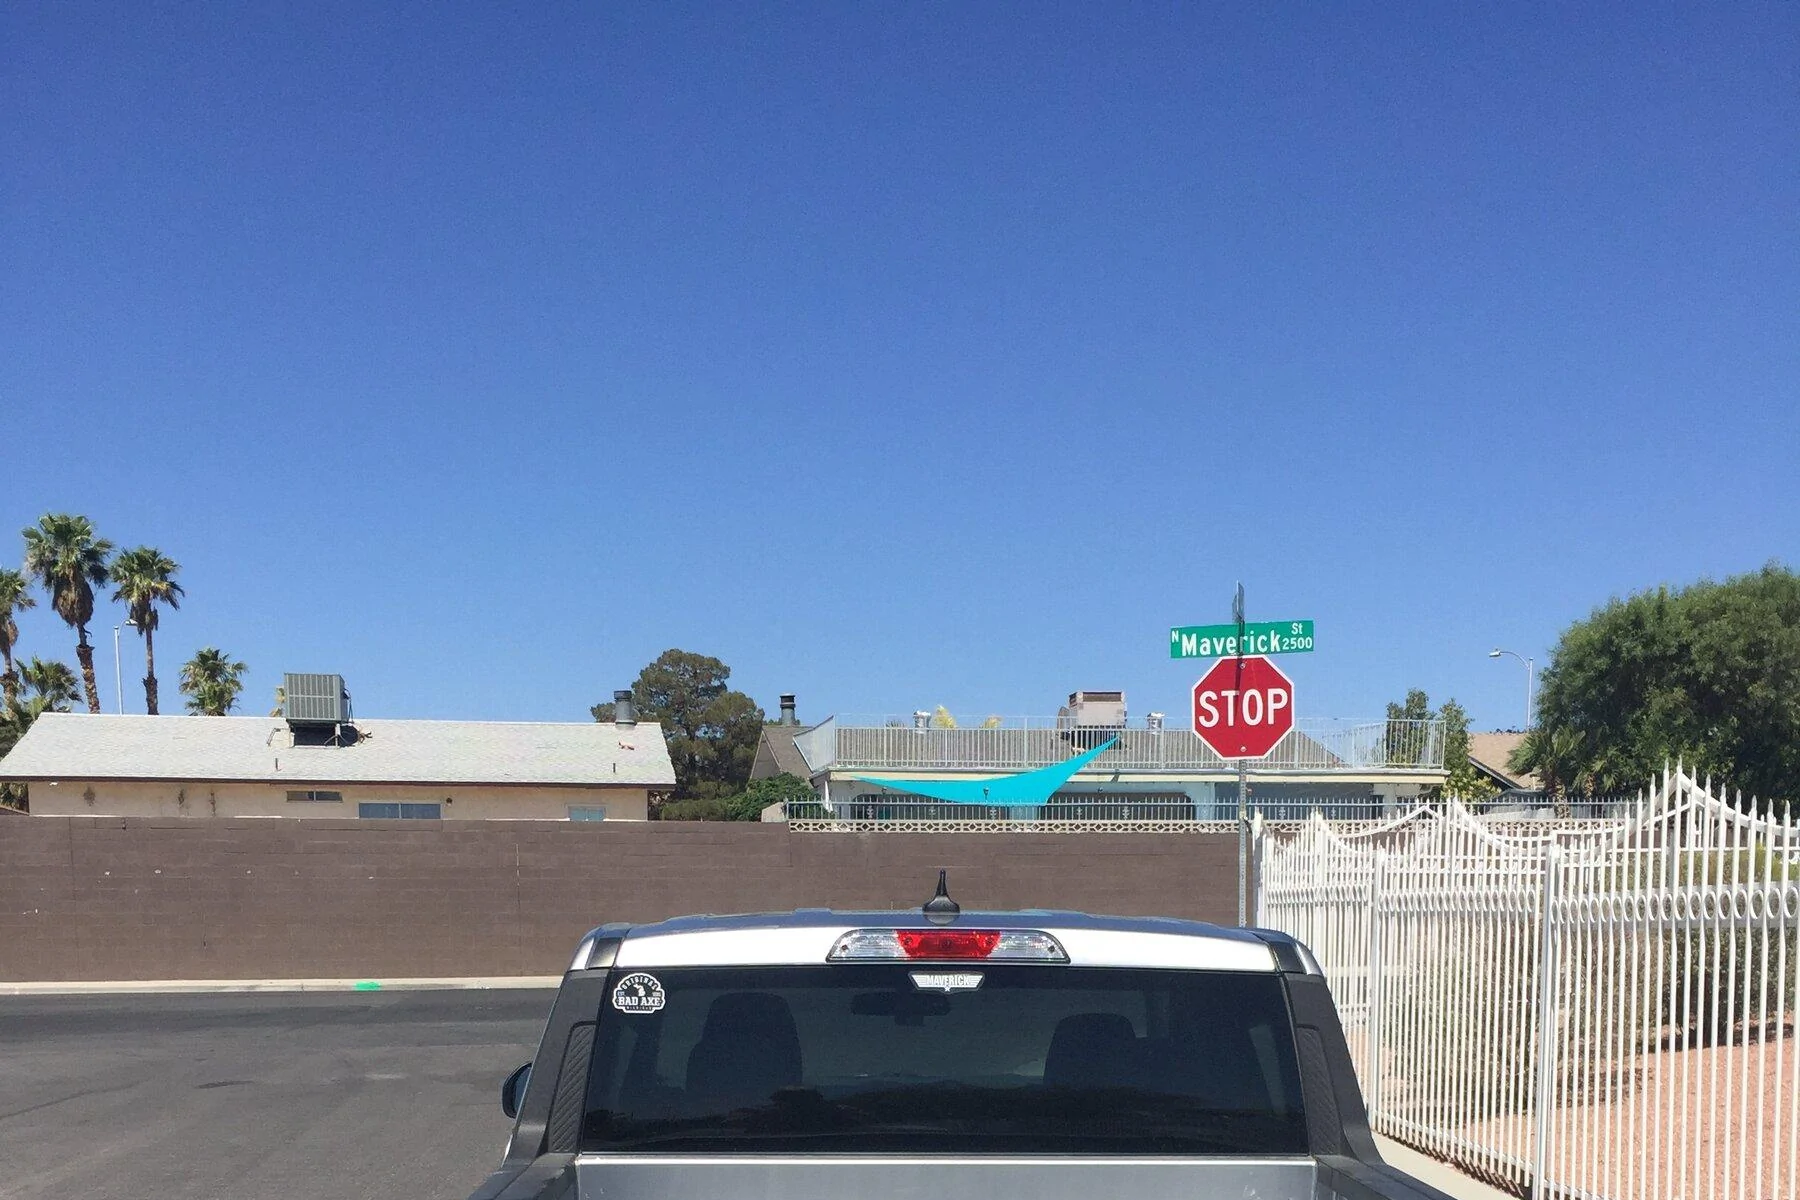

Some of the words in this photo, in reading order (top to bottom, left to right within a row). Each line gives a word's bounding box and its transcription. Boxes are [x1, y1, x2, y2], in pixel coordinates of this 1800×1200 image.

[1171, 630, 1179, 643] N
[1181, 630, 1281, 656] Maverick
[1291, 622, 1303, 635] St
[1282, 637, 1312, 650] 2500
[1199, 688, 1288, 728] STOP
[621, 976, 657, 990] ORIGINAL
[926, 974, 970, 986] MAVERICK
[618, 997, 638, 1006] BAD
[641, 997, 660, 1006] AXE
